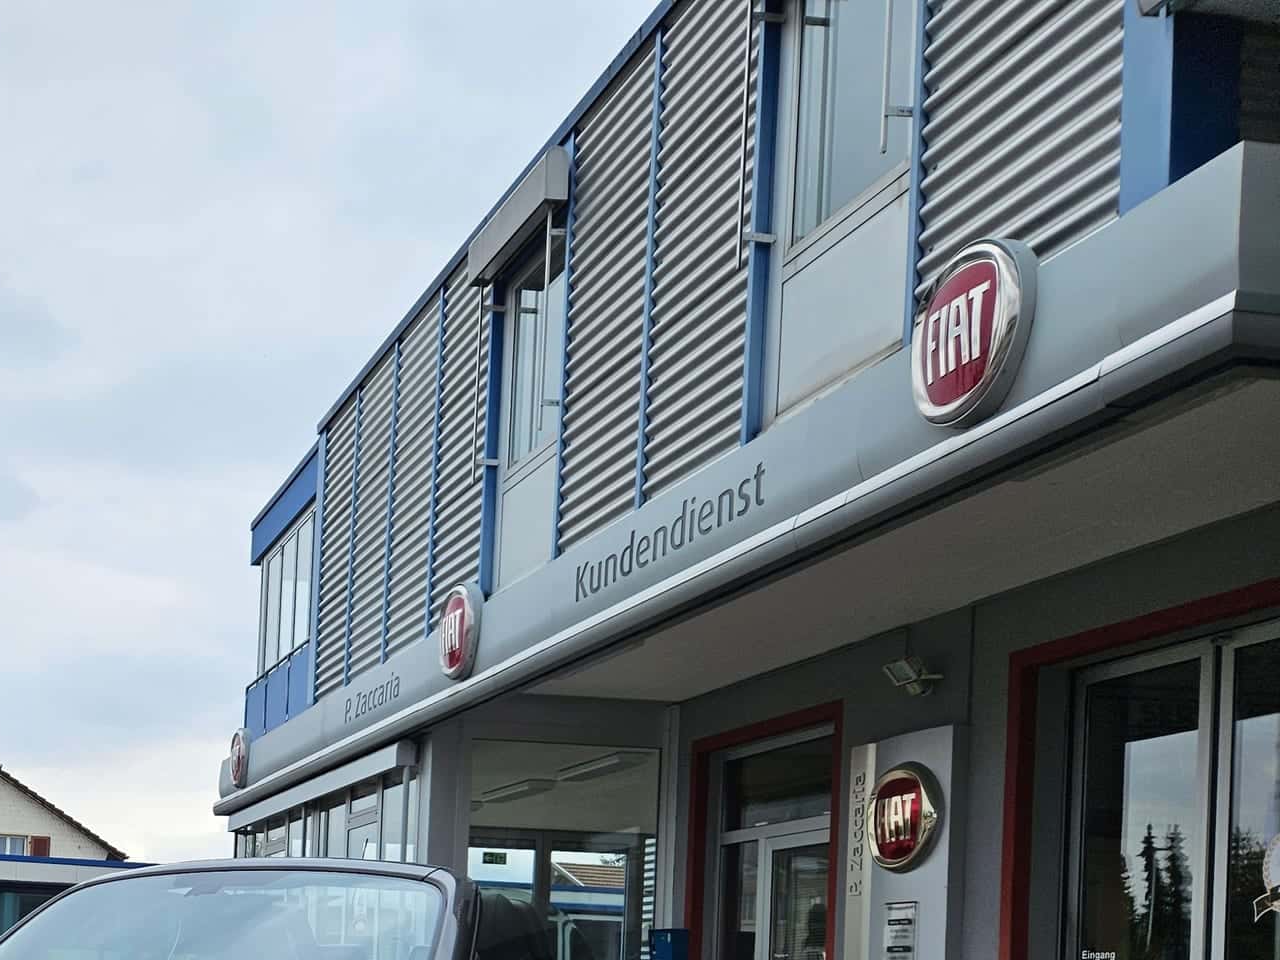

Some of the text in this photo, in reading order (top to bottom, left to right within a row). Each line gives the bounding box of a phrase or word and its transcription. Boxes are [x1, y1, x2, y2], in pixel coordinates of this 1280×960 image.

[927, 280, 991, 386] FIAT
[575, 462, 766, 602] Kundendienst
[344, 672, 401, 724] P. Zaccaria
[851, 771, 867, 872] Zaccaria
